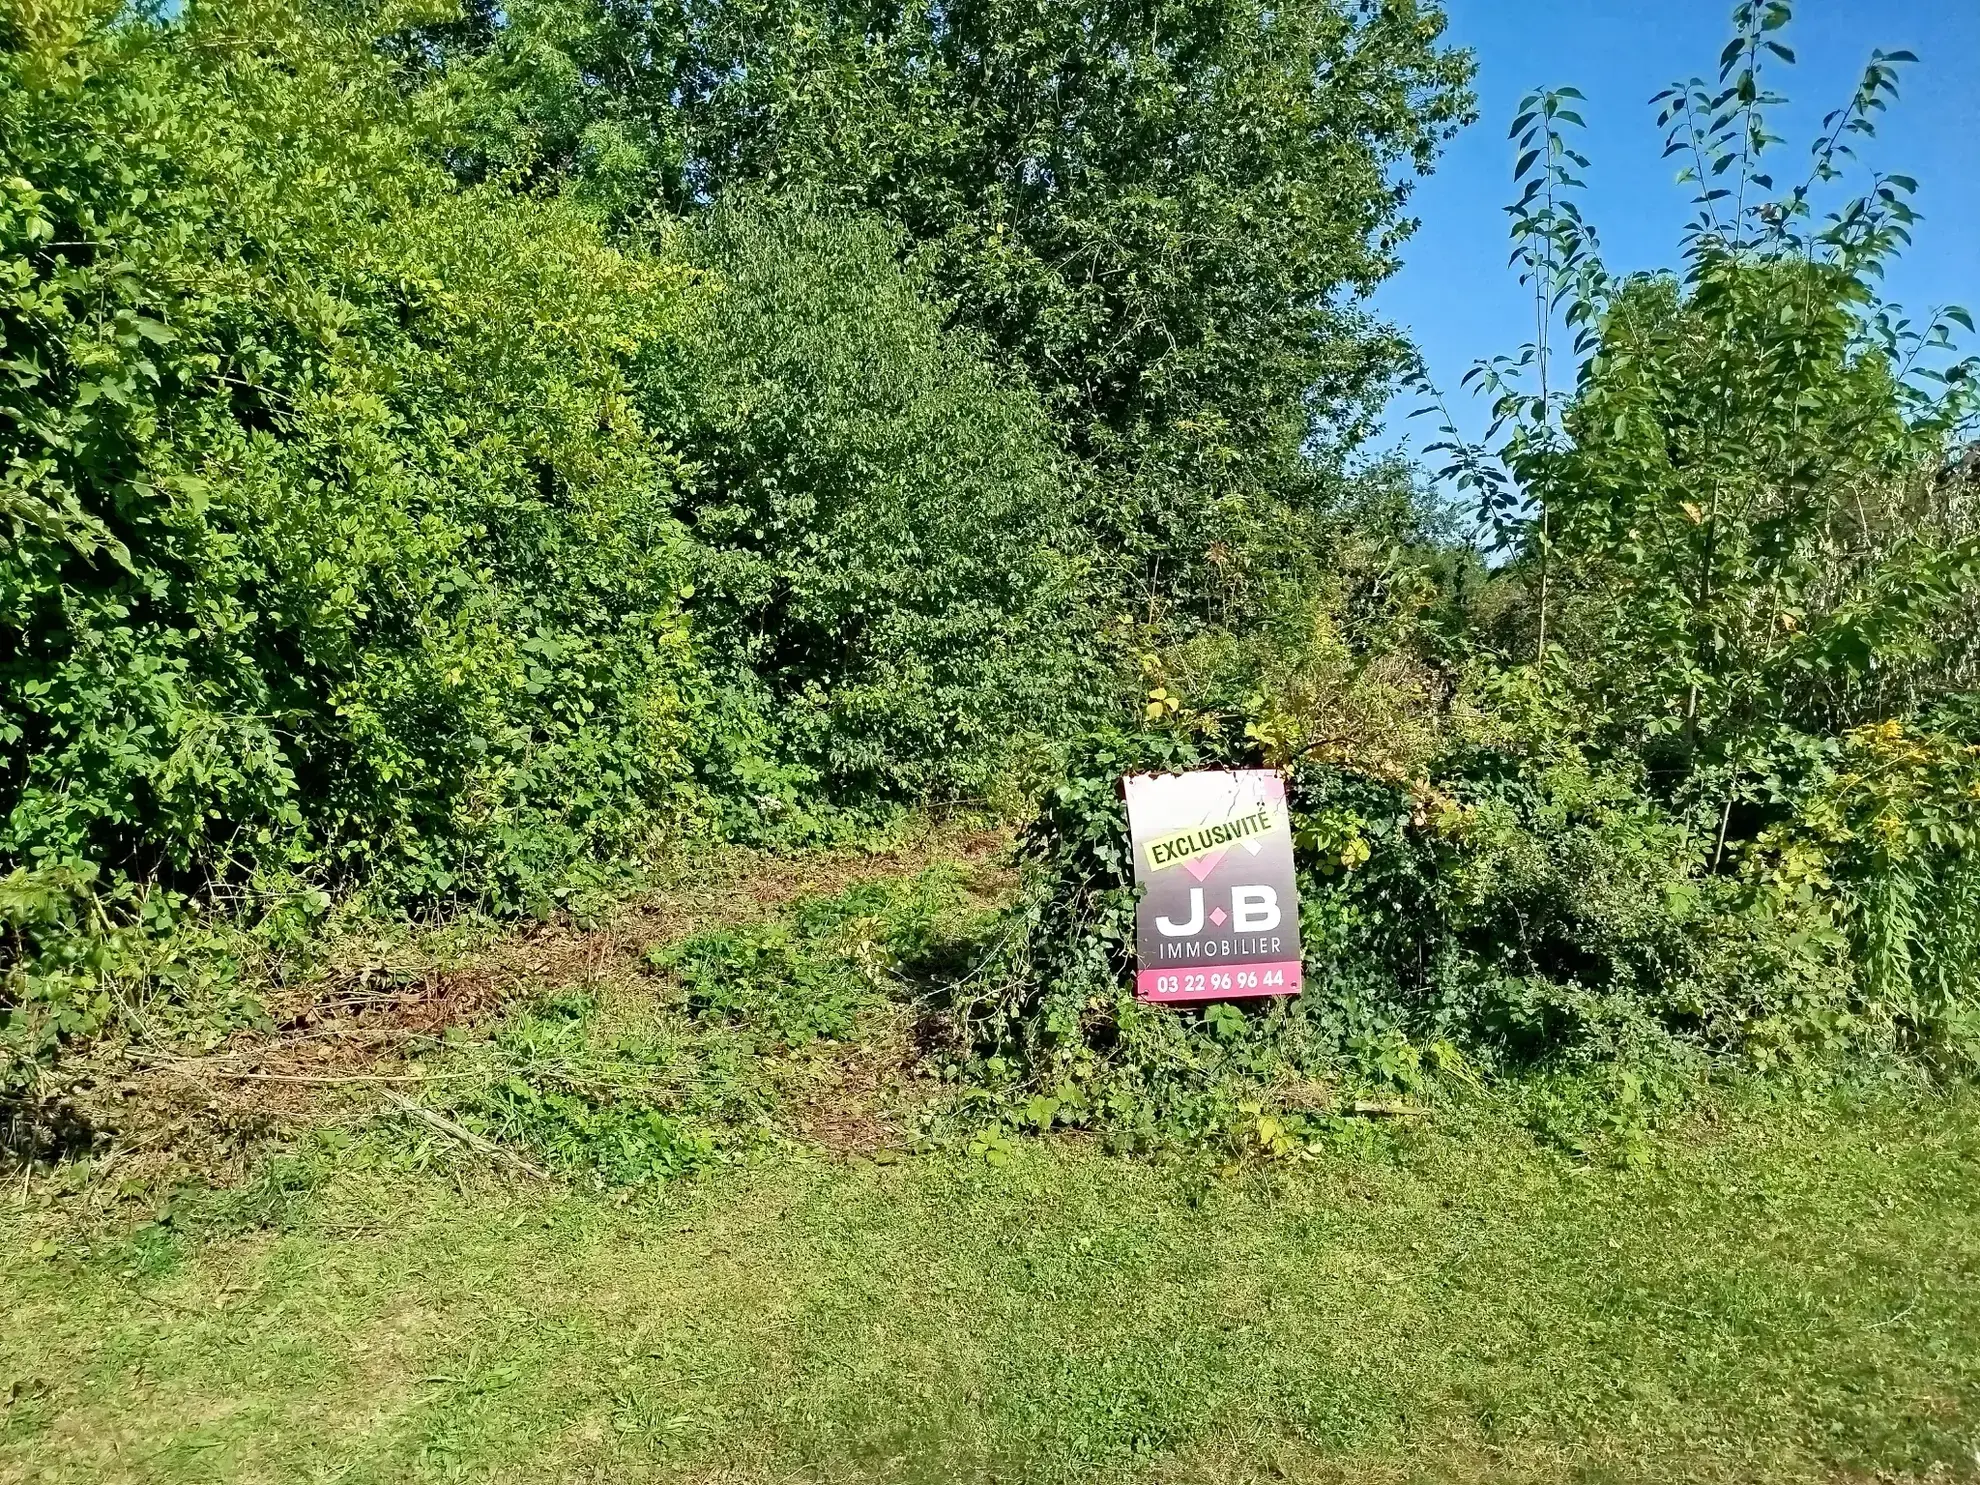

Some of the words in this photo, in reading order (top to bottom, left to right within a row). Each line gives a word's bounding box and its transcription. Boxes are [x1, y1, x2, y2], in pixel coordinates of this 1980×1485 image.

[1151, 807, 1272, 864] EXCLUSIVITÉ
[1159, 937, 1281, 959] IMMOBILIER
[1157, 976, 1179, 993] 03
[1184, 974, 1206, 992] 22
[1210, 972, 1232, 990] 96
[1236, 971, 1258, 989] 96
[1262, 969, 1284, 986] 44
